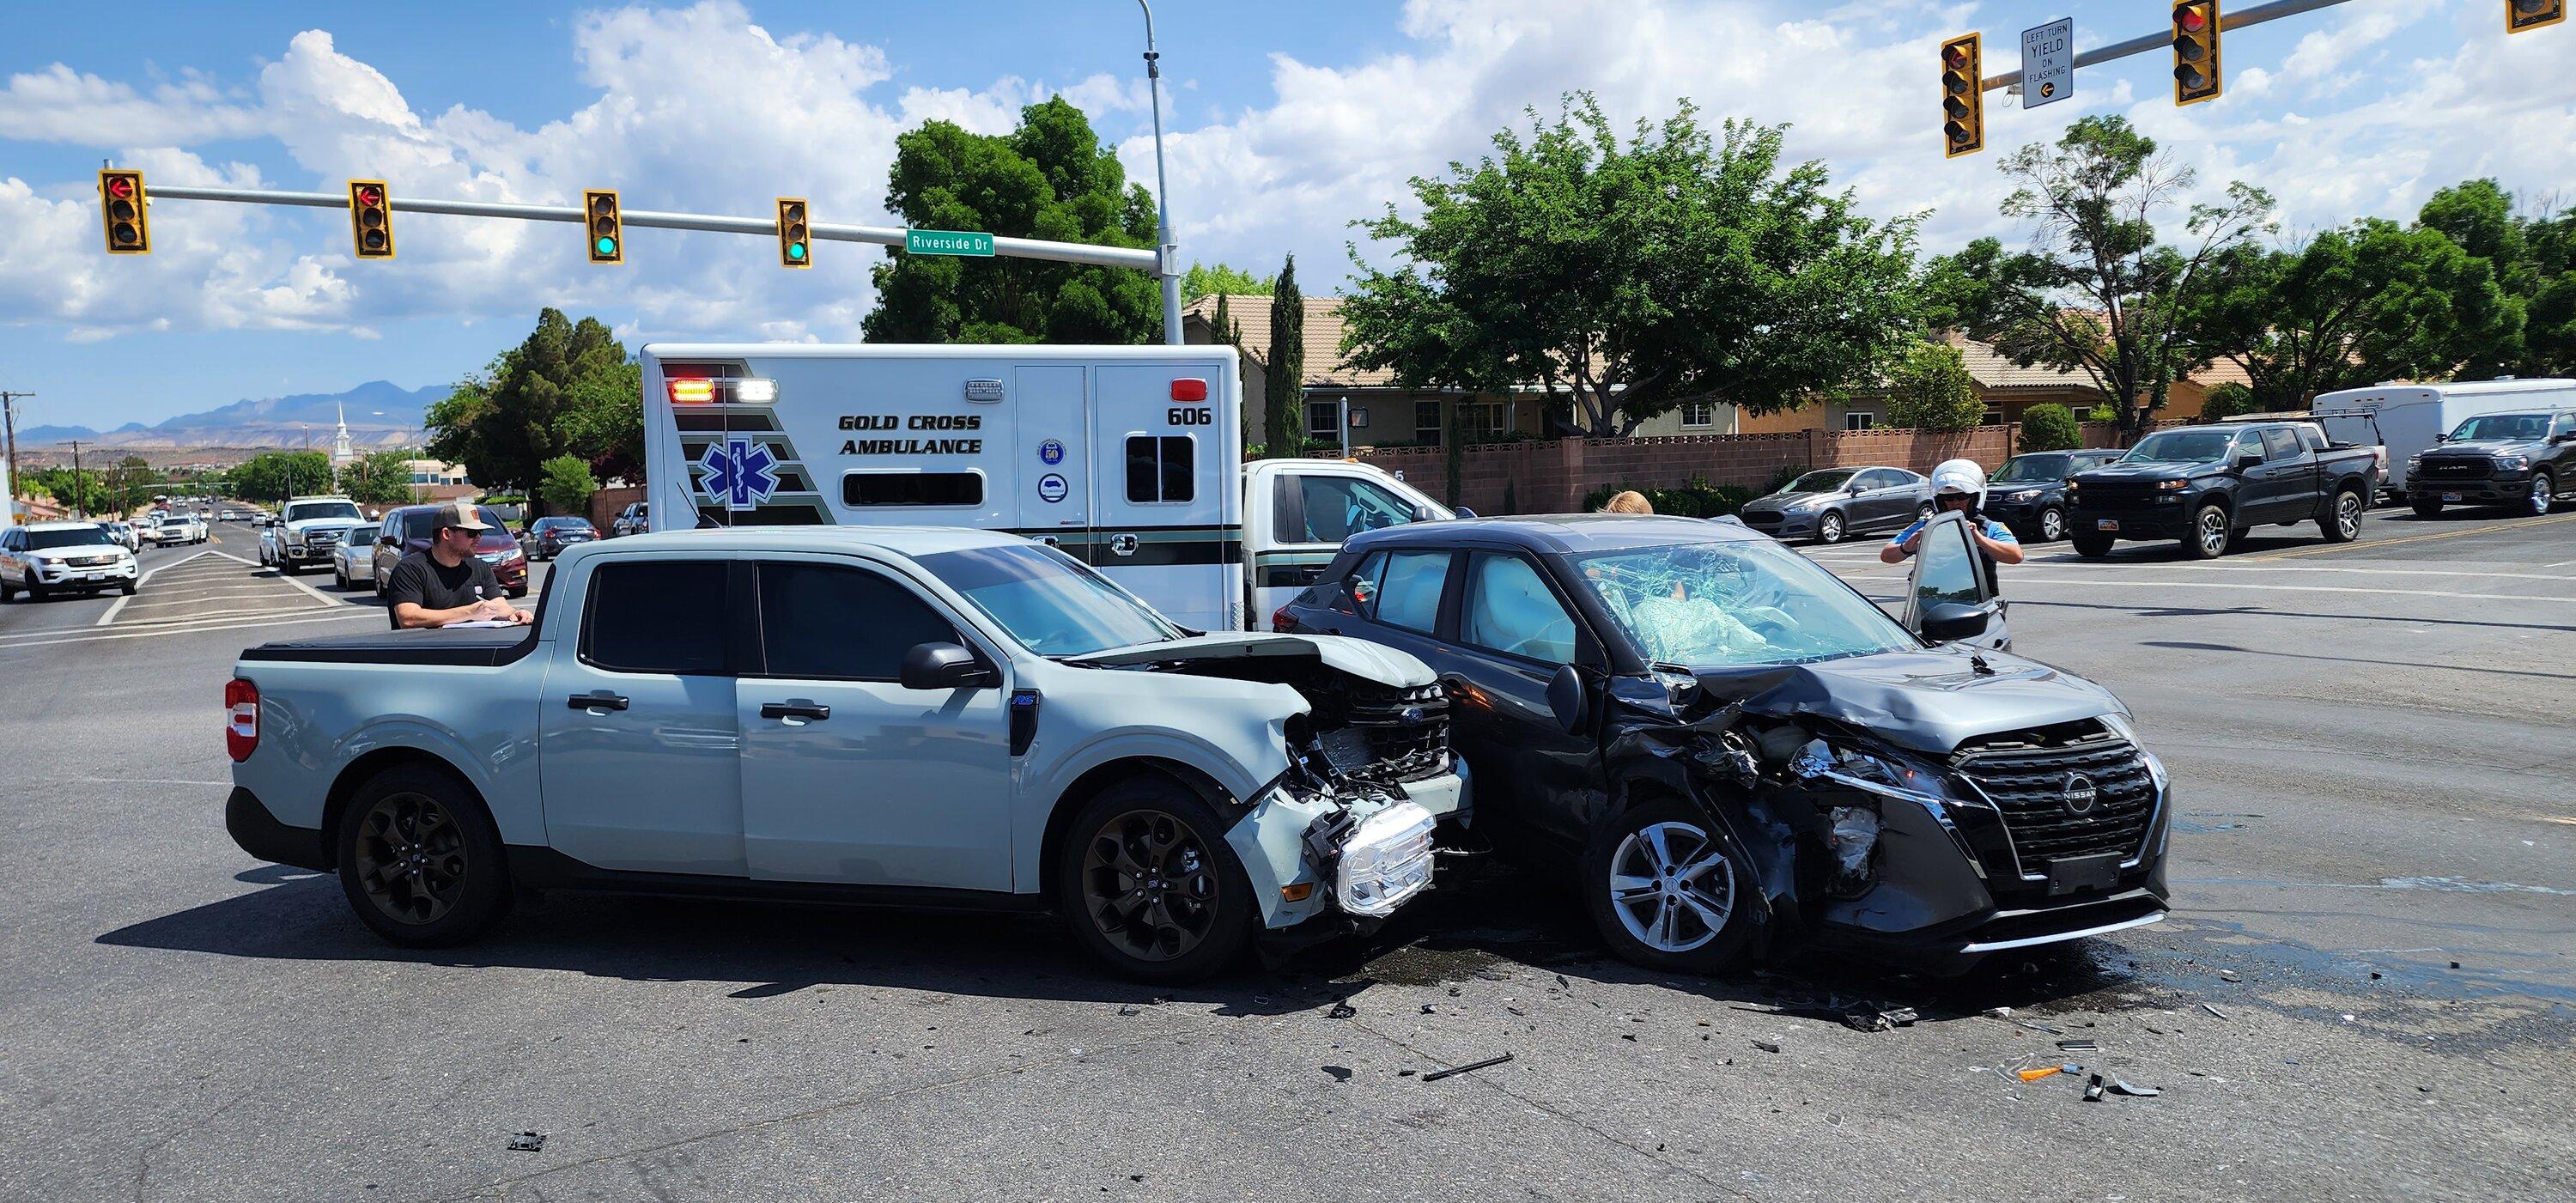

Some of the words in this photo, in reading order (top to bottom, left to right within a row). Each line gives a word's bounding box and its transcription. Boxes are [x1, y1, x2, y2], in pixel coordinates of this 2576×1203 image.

[2026, 31, 2044, 44] LEFT
[2048, 24, 2068, 37] TURN
[2032, 39, 2063, 58] YIELD
[2042, 57, 2053, 68] ON
[2029, 65, 2066, 83] FLASHING
[913, 235, 970, 250] Riverside
[975, 238, 987, 251] Dr
[838, 416, 899, 430] GOLD
[908, 416, 982, 430] CROSS
[1168, 407, 1212, 426] 606
[838, 439, 982, 455] AMBULANCE
[2063, 790, 2096, 799] NISSAN
